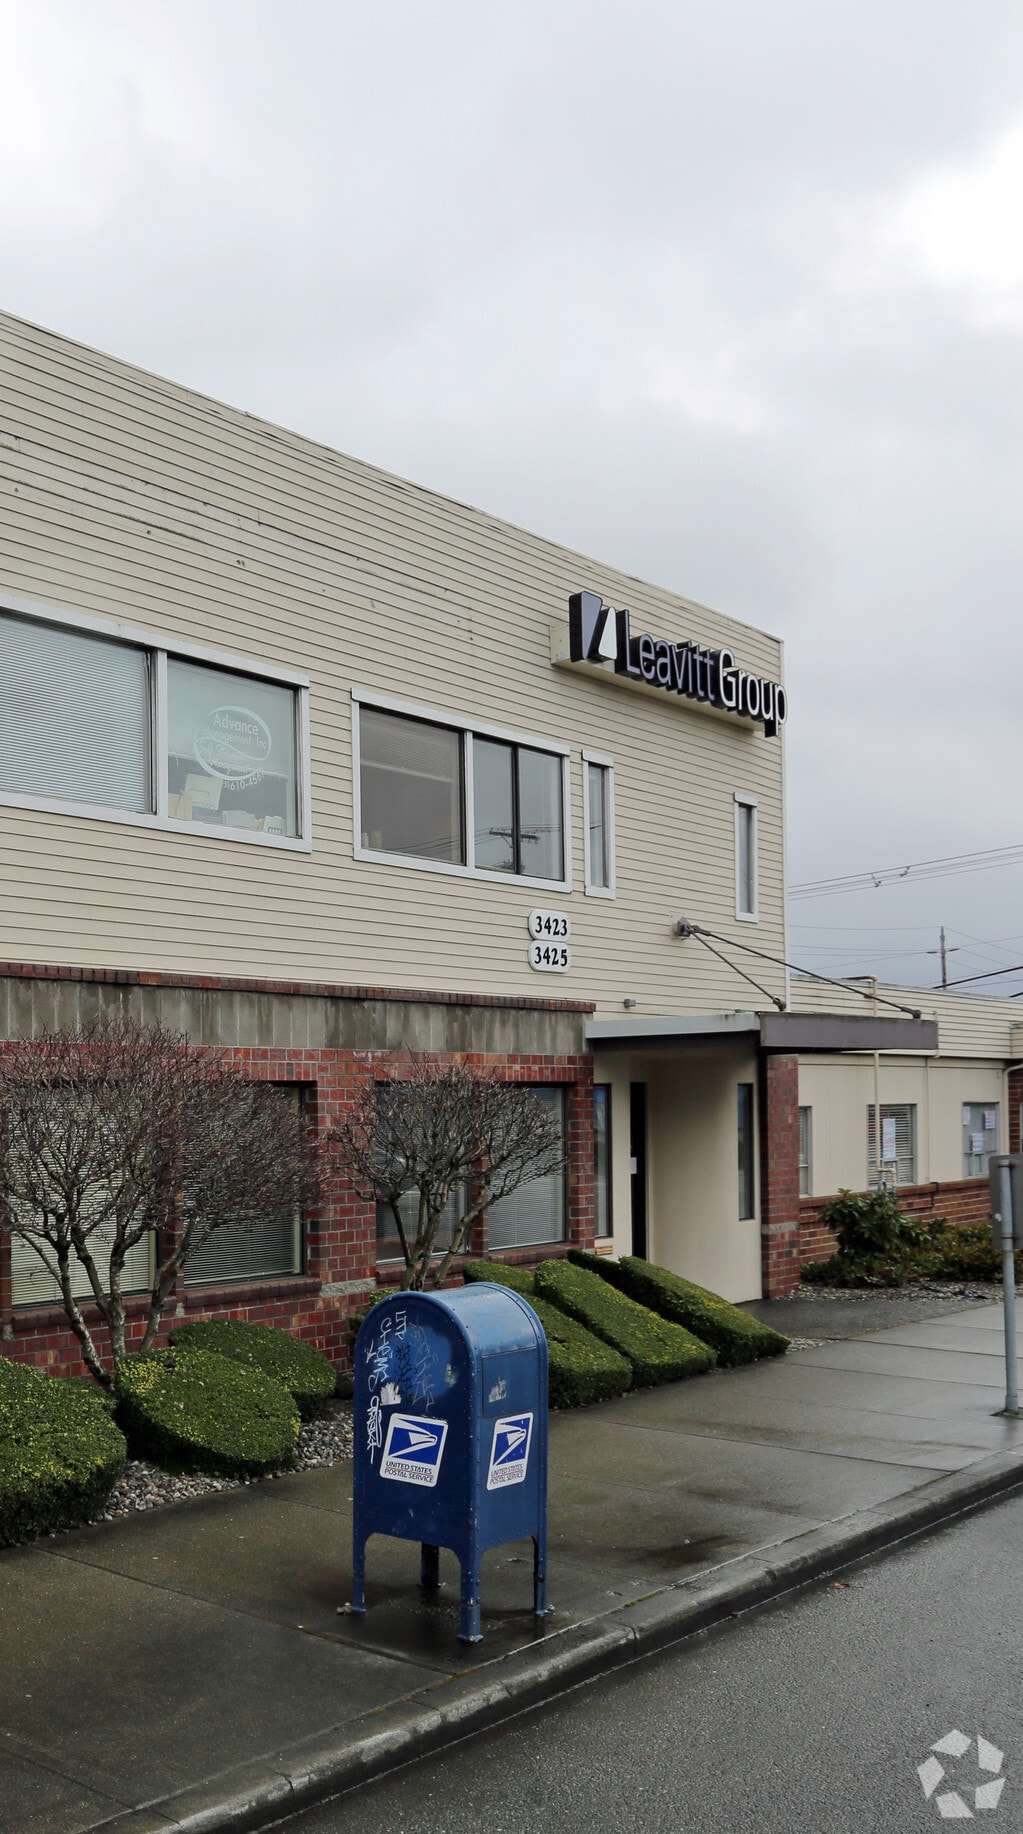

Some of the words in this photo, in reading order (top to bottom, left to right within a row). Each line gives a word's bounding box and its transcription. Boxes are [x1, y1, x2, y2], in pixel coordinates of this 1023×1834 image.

[616, 609, 715, 702] Leavitt
[716, 647, 788, 737] Group
[213, 712, 258, 735] Advance
[202, 726, 252, 745] Management
[534, 915, 568, 936] 3423
[534, 946, 568, 967] 3425
[384, 1468, 408, 1478] POSTAL
[408, 1472, 434, 1483] SERVICE
[386, 1460, 410, 1470] UNITED
[410, 1465, 433, 1475] STATES
[491, 1467, 507, 1477] UNITED
[490, 1475, 506, 1485] POSTAL
